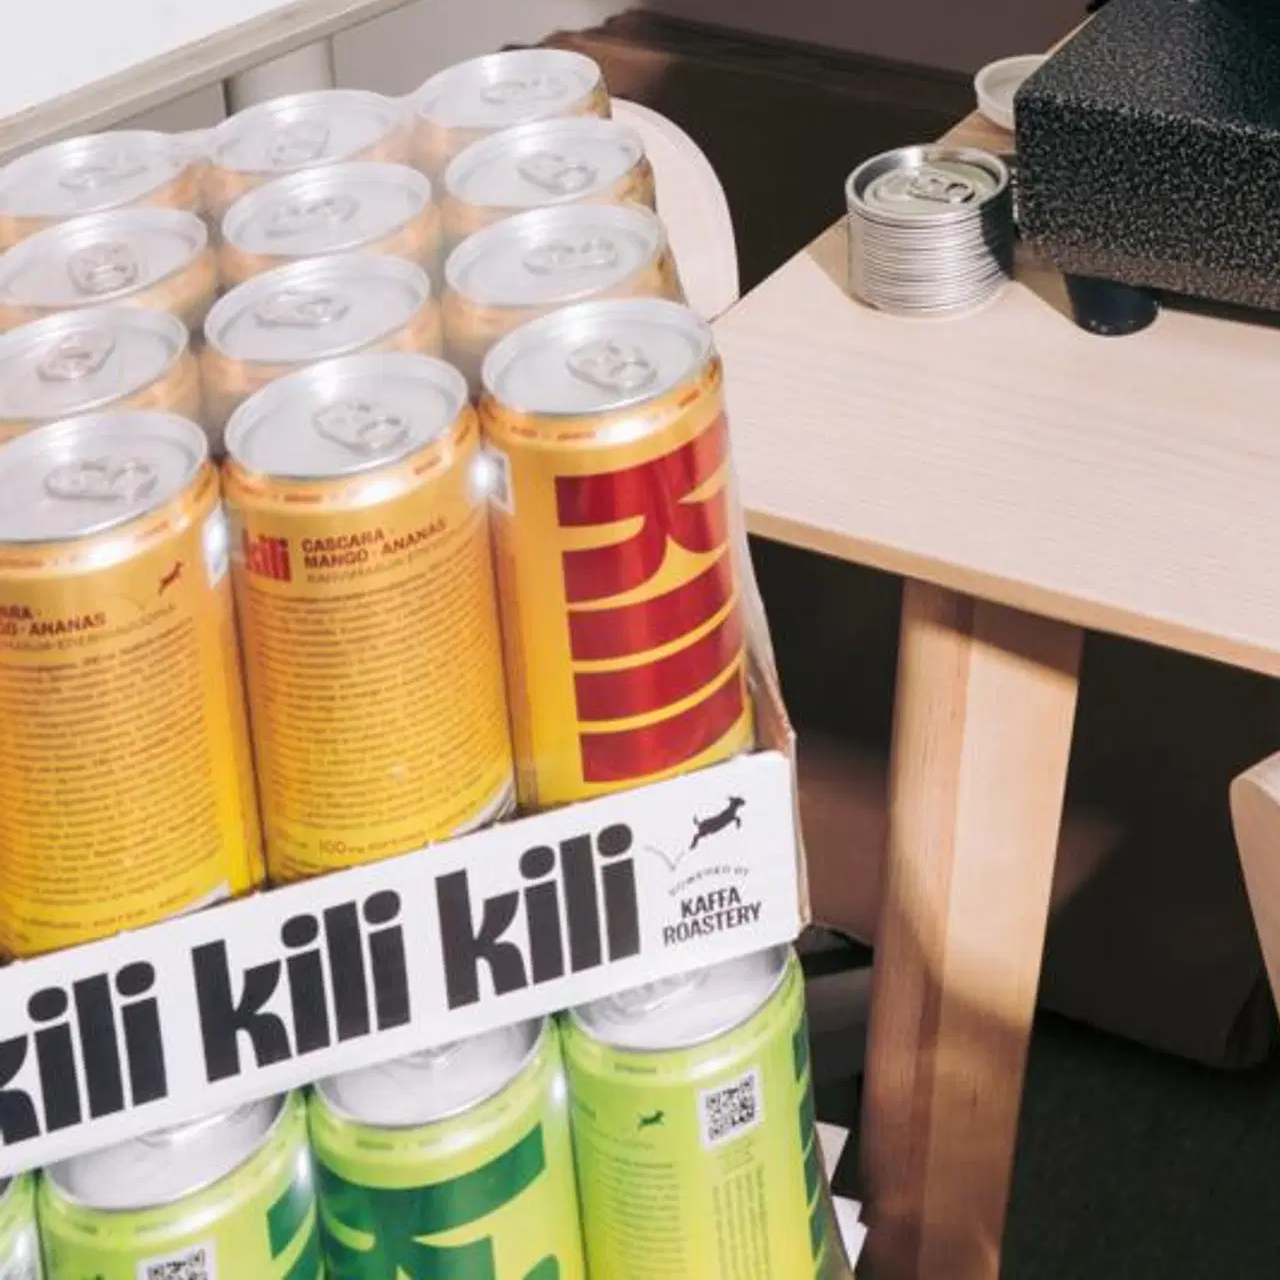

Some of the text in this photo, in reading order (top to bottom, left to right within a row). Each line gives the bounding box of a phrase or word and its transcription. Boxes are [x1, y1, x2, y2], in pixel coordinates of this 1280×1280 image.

[300, 527, 386, 554] CASCARA
[304, 548, 369, 570] MANGO
[29, 612, 107, 636] ANANAS
[435, 822, 641, 1012] kili
[680, 886, 742, 919] KAFFA
[662, 900, 762, 948] ROASTERY
[191, 889, 411, 1085] kili
